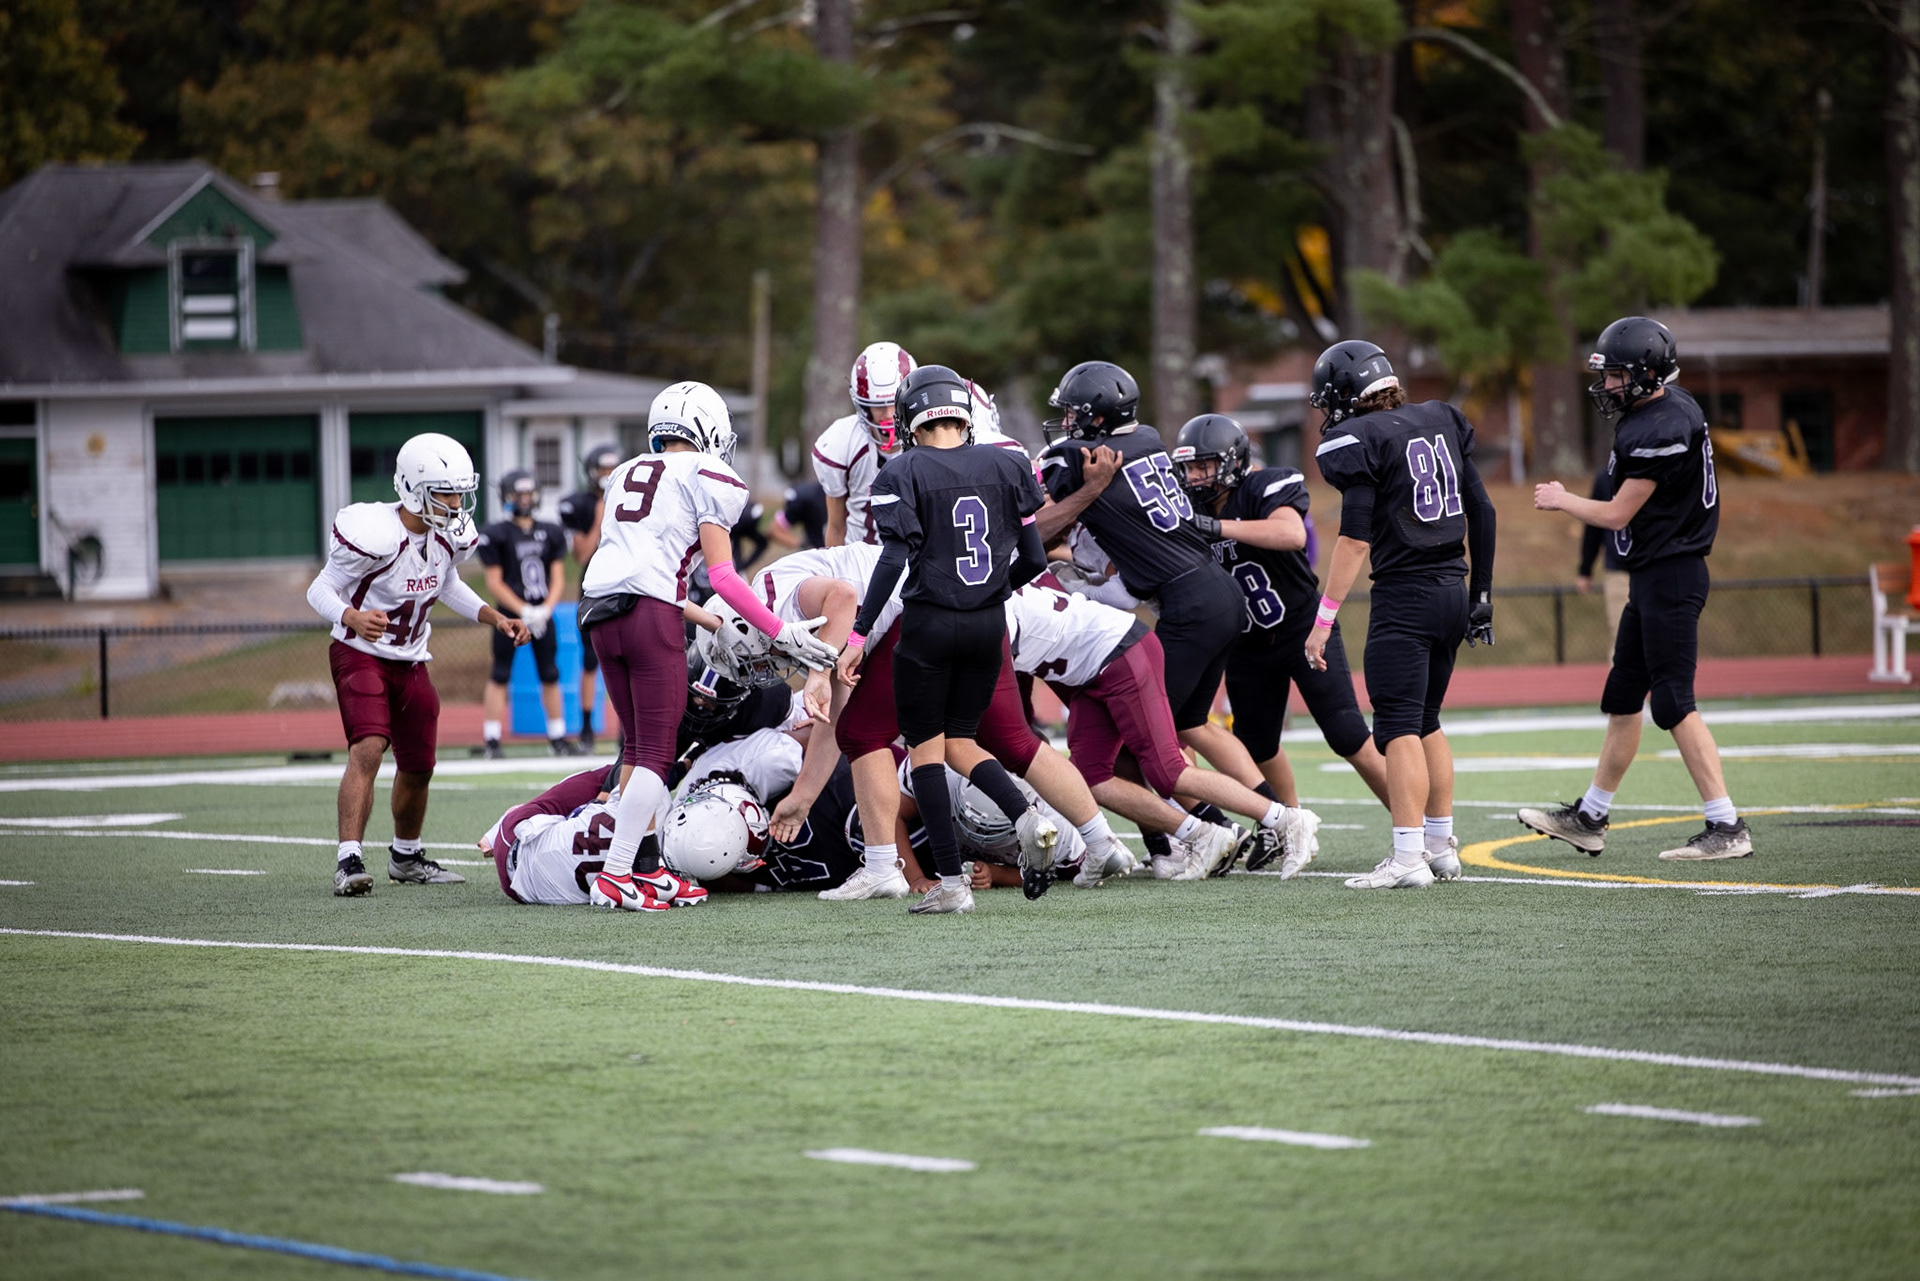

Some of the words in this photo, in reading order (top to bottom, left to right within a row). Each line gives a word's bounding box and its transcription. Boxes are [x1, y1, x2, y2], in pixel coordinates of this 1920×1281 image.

[926, 408, 961, 419] Riddell
[614, 459, 667, 523] 9
[1121, 451, 1194, 533] 55
[1405, 433, 1463, 522] 81
[952, 495, 993, 586] 3
[406, 575, 438, 593] RAMS
